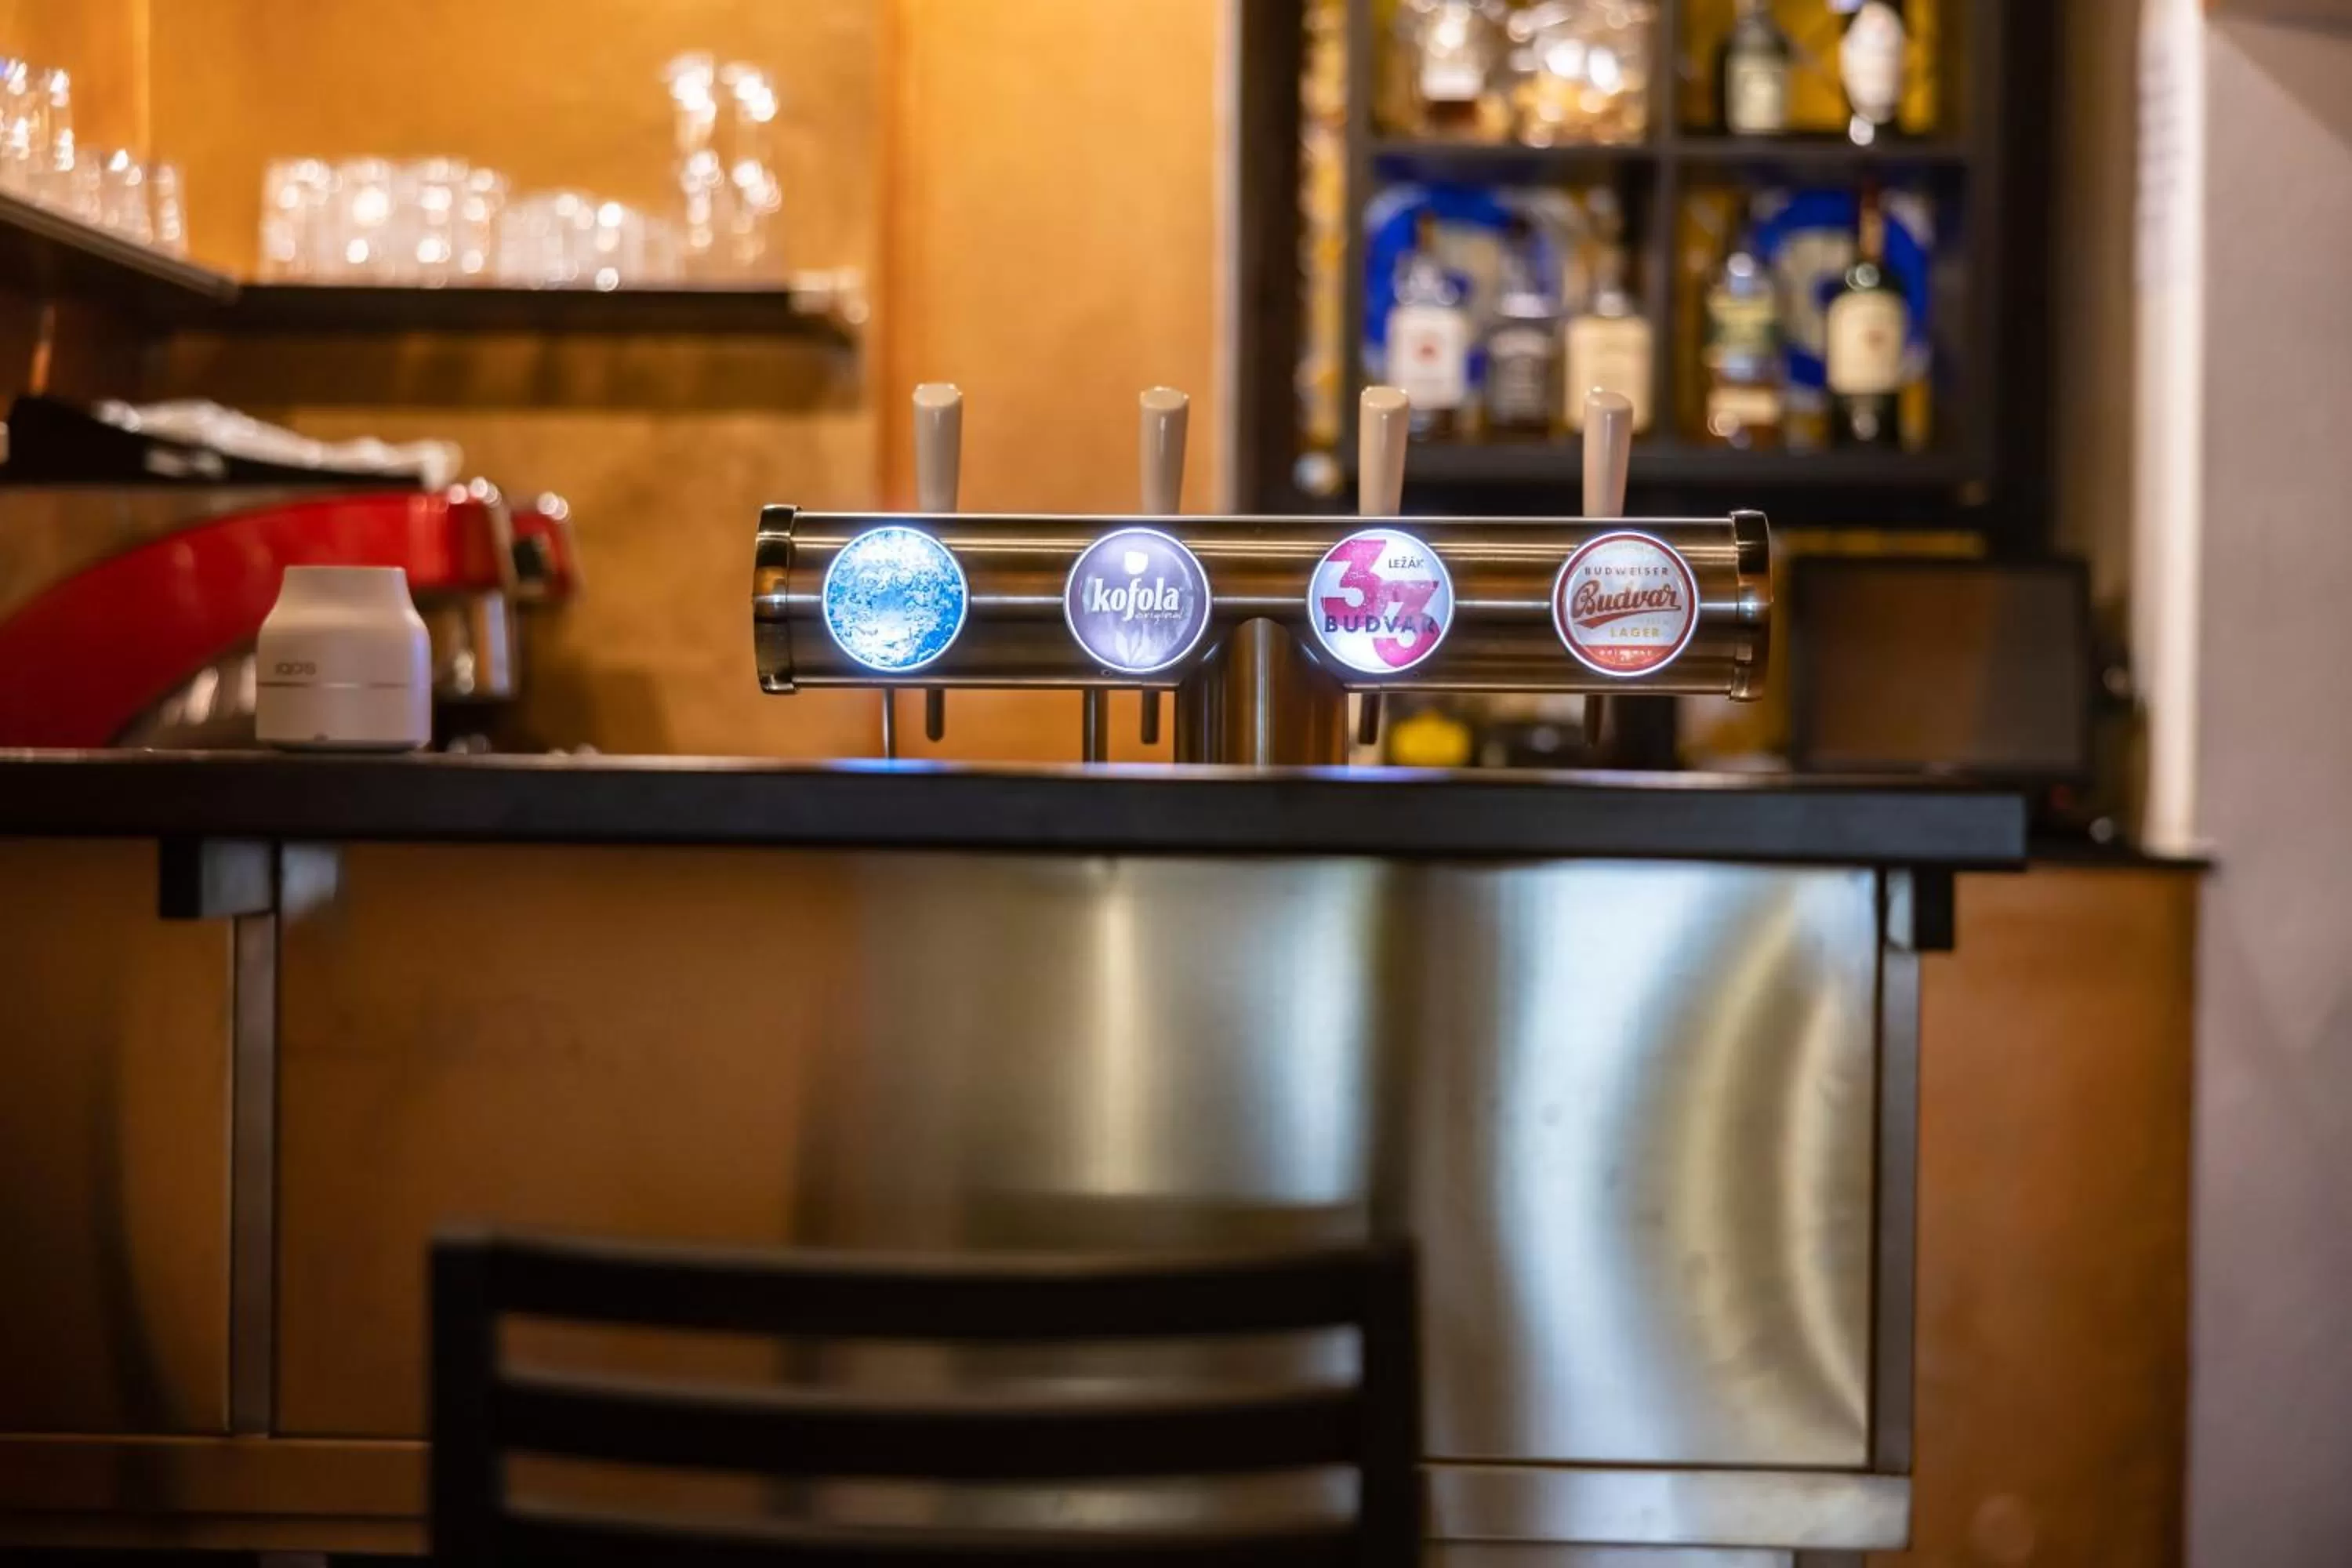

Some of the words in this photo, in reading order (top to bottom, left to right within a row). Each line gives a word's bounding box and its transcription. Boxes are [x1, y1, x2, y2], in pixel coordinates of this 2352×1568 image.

[1584, 567, 1669, 576] BUDWEISER
[1091, 577, 1180, 622] kofola
[1571, 579, 1681, 619] Budvar
[1324, 615, 1436, 633] BUDVAR
[1610, 627, 1660, 637] LAGER
